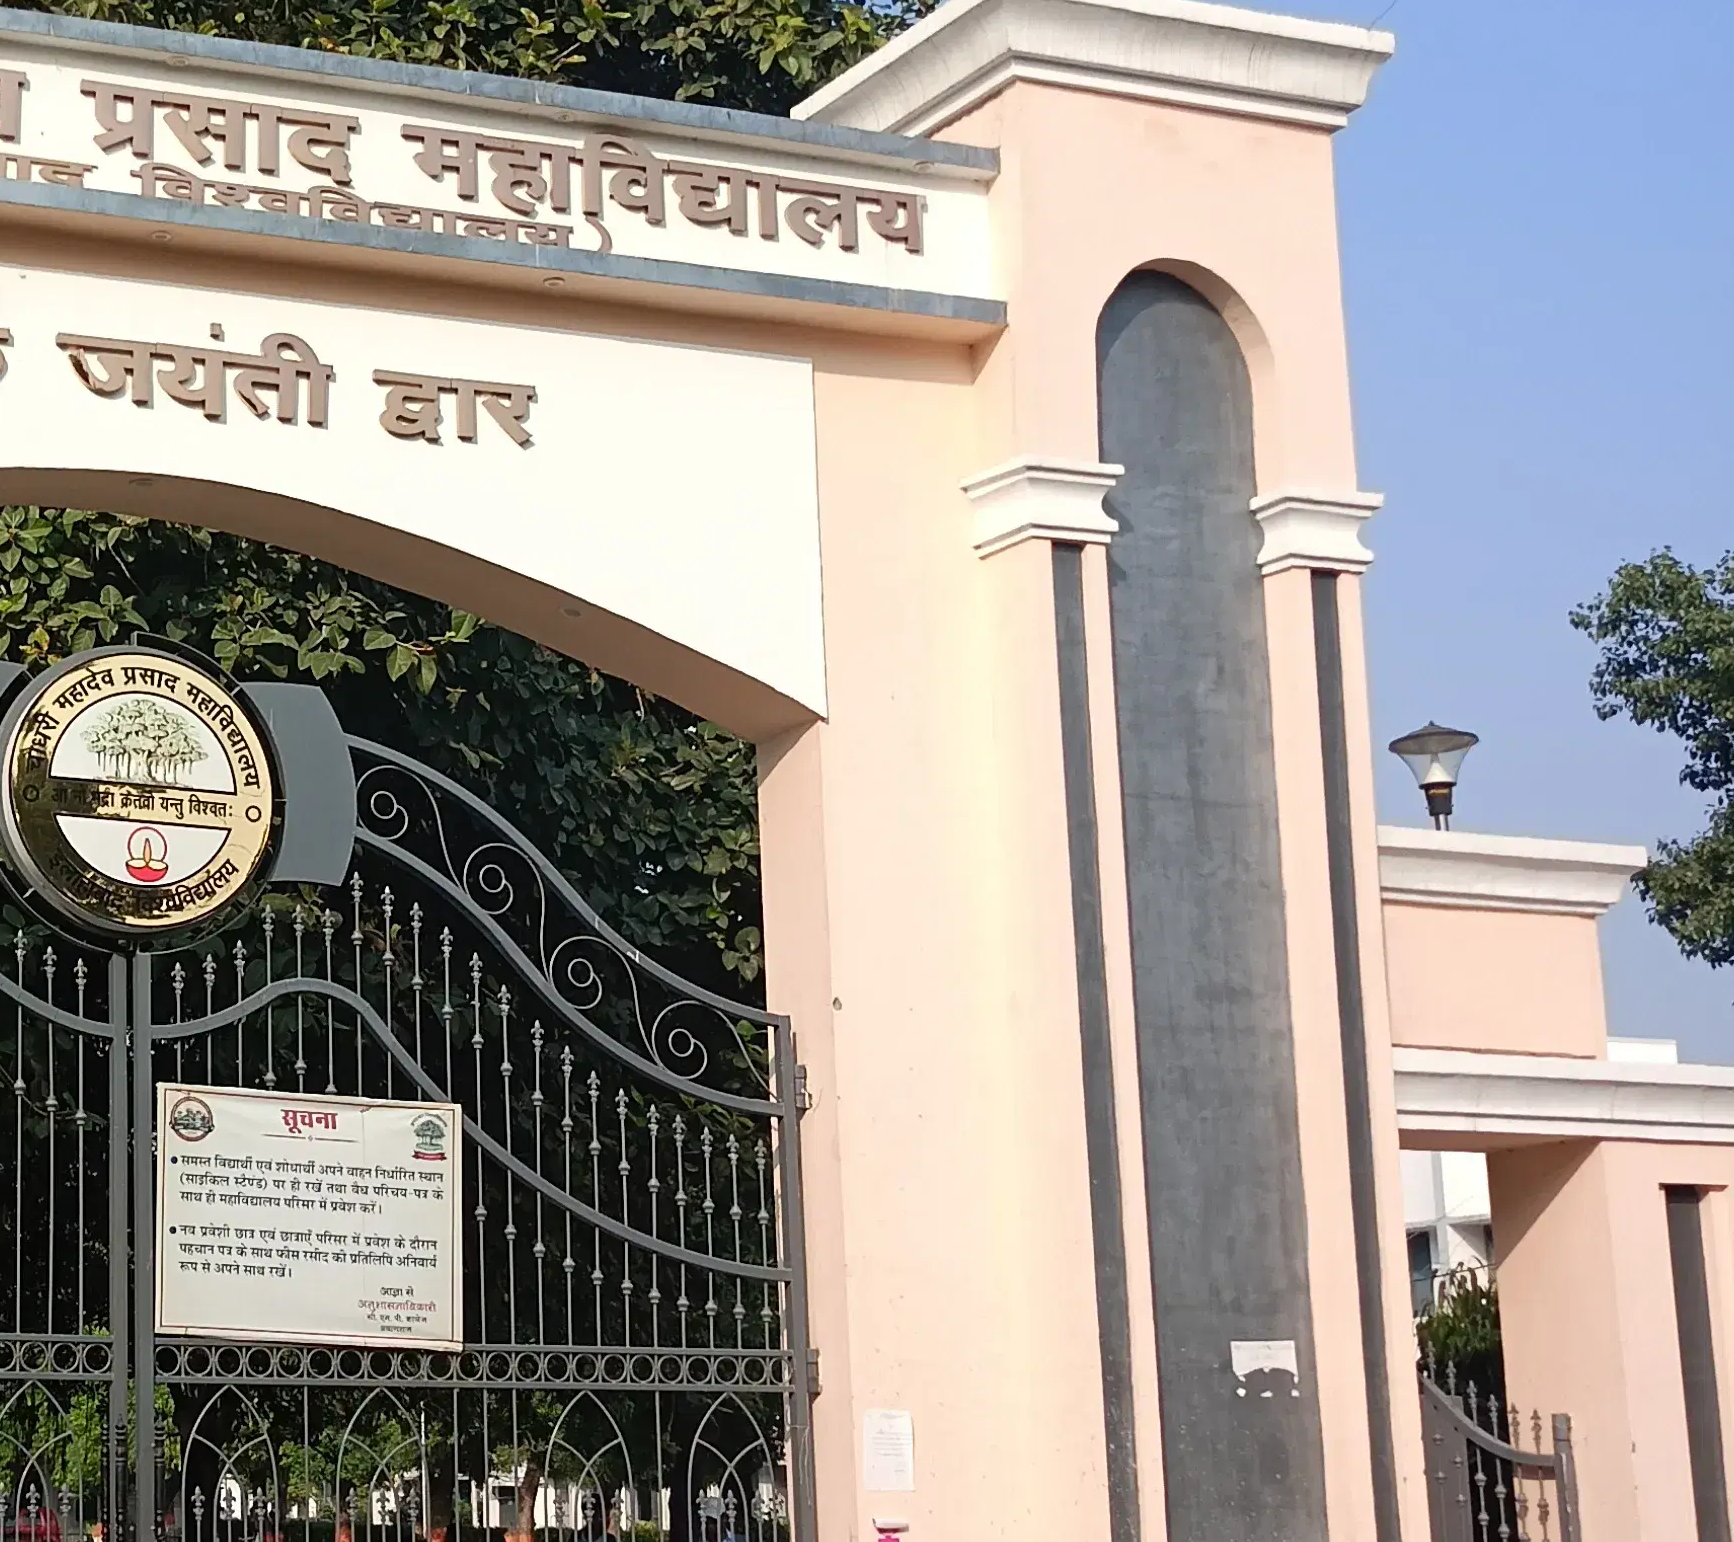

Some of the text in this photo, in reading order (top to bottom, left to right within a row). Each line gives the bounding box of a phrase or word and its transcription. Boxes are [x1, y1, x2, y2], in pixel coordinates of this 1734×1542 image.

[79, 78, 361, 187] प्रसाद
[401, 126, 928, 254] महाविद्यालय
[56, 320, 335, 429] जयंती
[372, 367, 538, 449] द्वार
[52, 668, 115, 709] महादेव
[121, 666, 181, 694] प्रसाद
[186, 681, 261, 791] महाविद्यालय
[158, 796, 184, 820] यन्तु
[280, 1108, 339, 1134] सूचना
[180, 1154, 444, 1182] समस्त विद्यार्थी एवं शोधार्थी अपने वाहन निर्धारित स्थान
[180, 1191, 203, 1203] साथ
[205, 1189, 216, 1205] ही
[219, 1192, 281, 1207] महाविद्यालय
[283, 1195, 316, 1210] परिसर
[319, 1197, 327, 1211] में
[330, 1198, 357, 1213] प्रवेश
[272, 1179, 286, 1190] पर
[289, 1177, 301, 1192] ही
[305, 1178, 323, 1192] रखें
[326, 1183, 347, 1195] तथा
[351, 1180, 369, 1195] वैध
[431, 1185, 444, 1200] के
[179, 1224, 196, 1235] नव
[199, 1222, 230, 1239] प्रवेशी
[234, 1227, 255, 1240] छात्र
[259, 1227, 277, 1244] एवं
[315, 1230, 348, 1246] परिसर
[351, 1232, 361, 1246] में
[364, 1233, 390, 1249] प्रवेश
[394, 1234, 406, 1249] के
[409, 1235, 438, 1251] दौरान
[179, 1243, 215, 1256] पहचान
[217, 1245, 233, 1256] पत्र
[235, 1243, 248, 1257] के
[250, 1247, 273, 1259] साथ
[275, 1245, 300, 1260] फीस
[302, 1247, 330, 1263] रसीद
[350, 1250, 393, 1266] प्रतिलिपि
[396, 1254, 438, 1268] अनिवार्य
[179, 1260, 198, 1272] रूप
[200, 1259, 211, 1273] से
[214, 1260, 240, 1274] अपने
[243, 1264, 266, 1276] साथ
